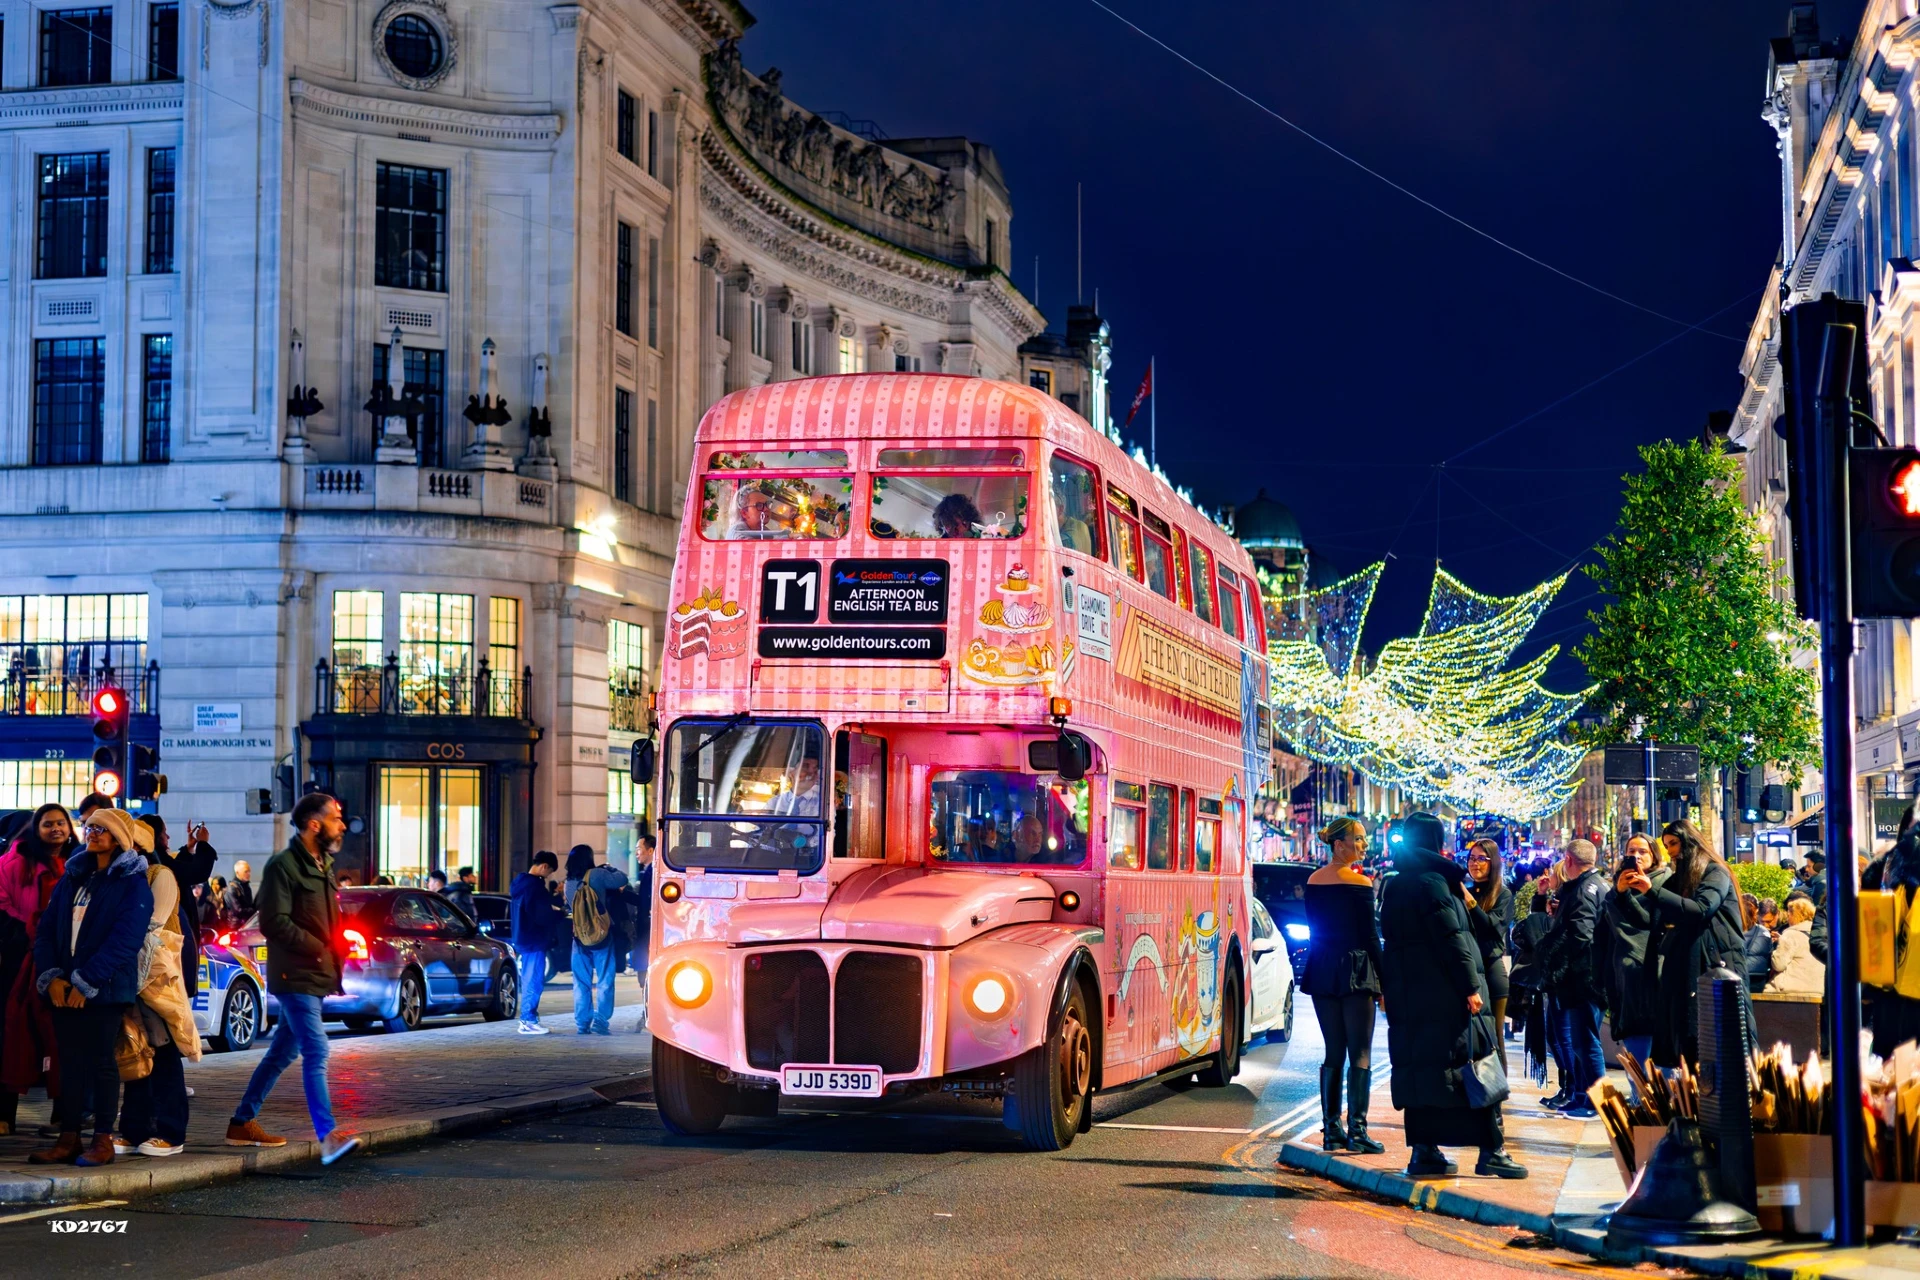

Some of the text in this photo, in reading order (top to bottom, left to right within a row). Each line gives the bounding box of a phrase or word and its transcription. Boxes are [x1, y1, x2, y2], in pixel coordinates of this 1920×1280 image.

[860, 571, 917, 580] GoldenTours
[767, 571, 817, 611] T1
[849, 589, 925, 600] AFTERNOON
[834, 600, 939, 612] ENGLISH TEA BUS
[1081, 593, 1106, 617] CHAMOMILE
[1081, 613, 1095, 634] DRIVE
[773, 635, 931, 651] www.goldentours.com
[1143, 631, 1239, 704] THE ENGLISH TEA BUS
[177, 738, 245, 748] MARLBOROUGH
[427, 742, 466, 759] COS
[45, 749, 65, 758] 222
[792, 1072, 872, 1090] JJD 539D
